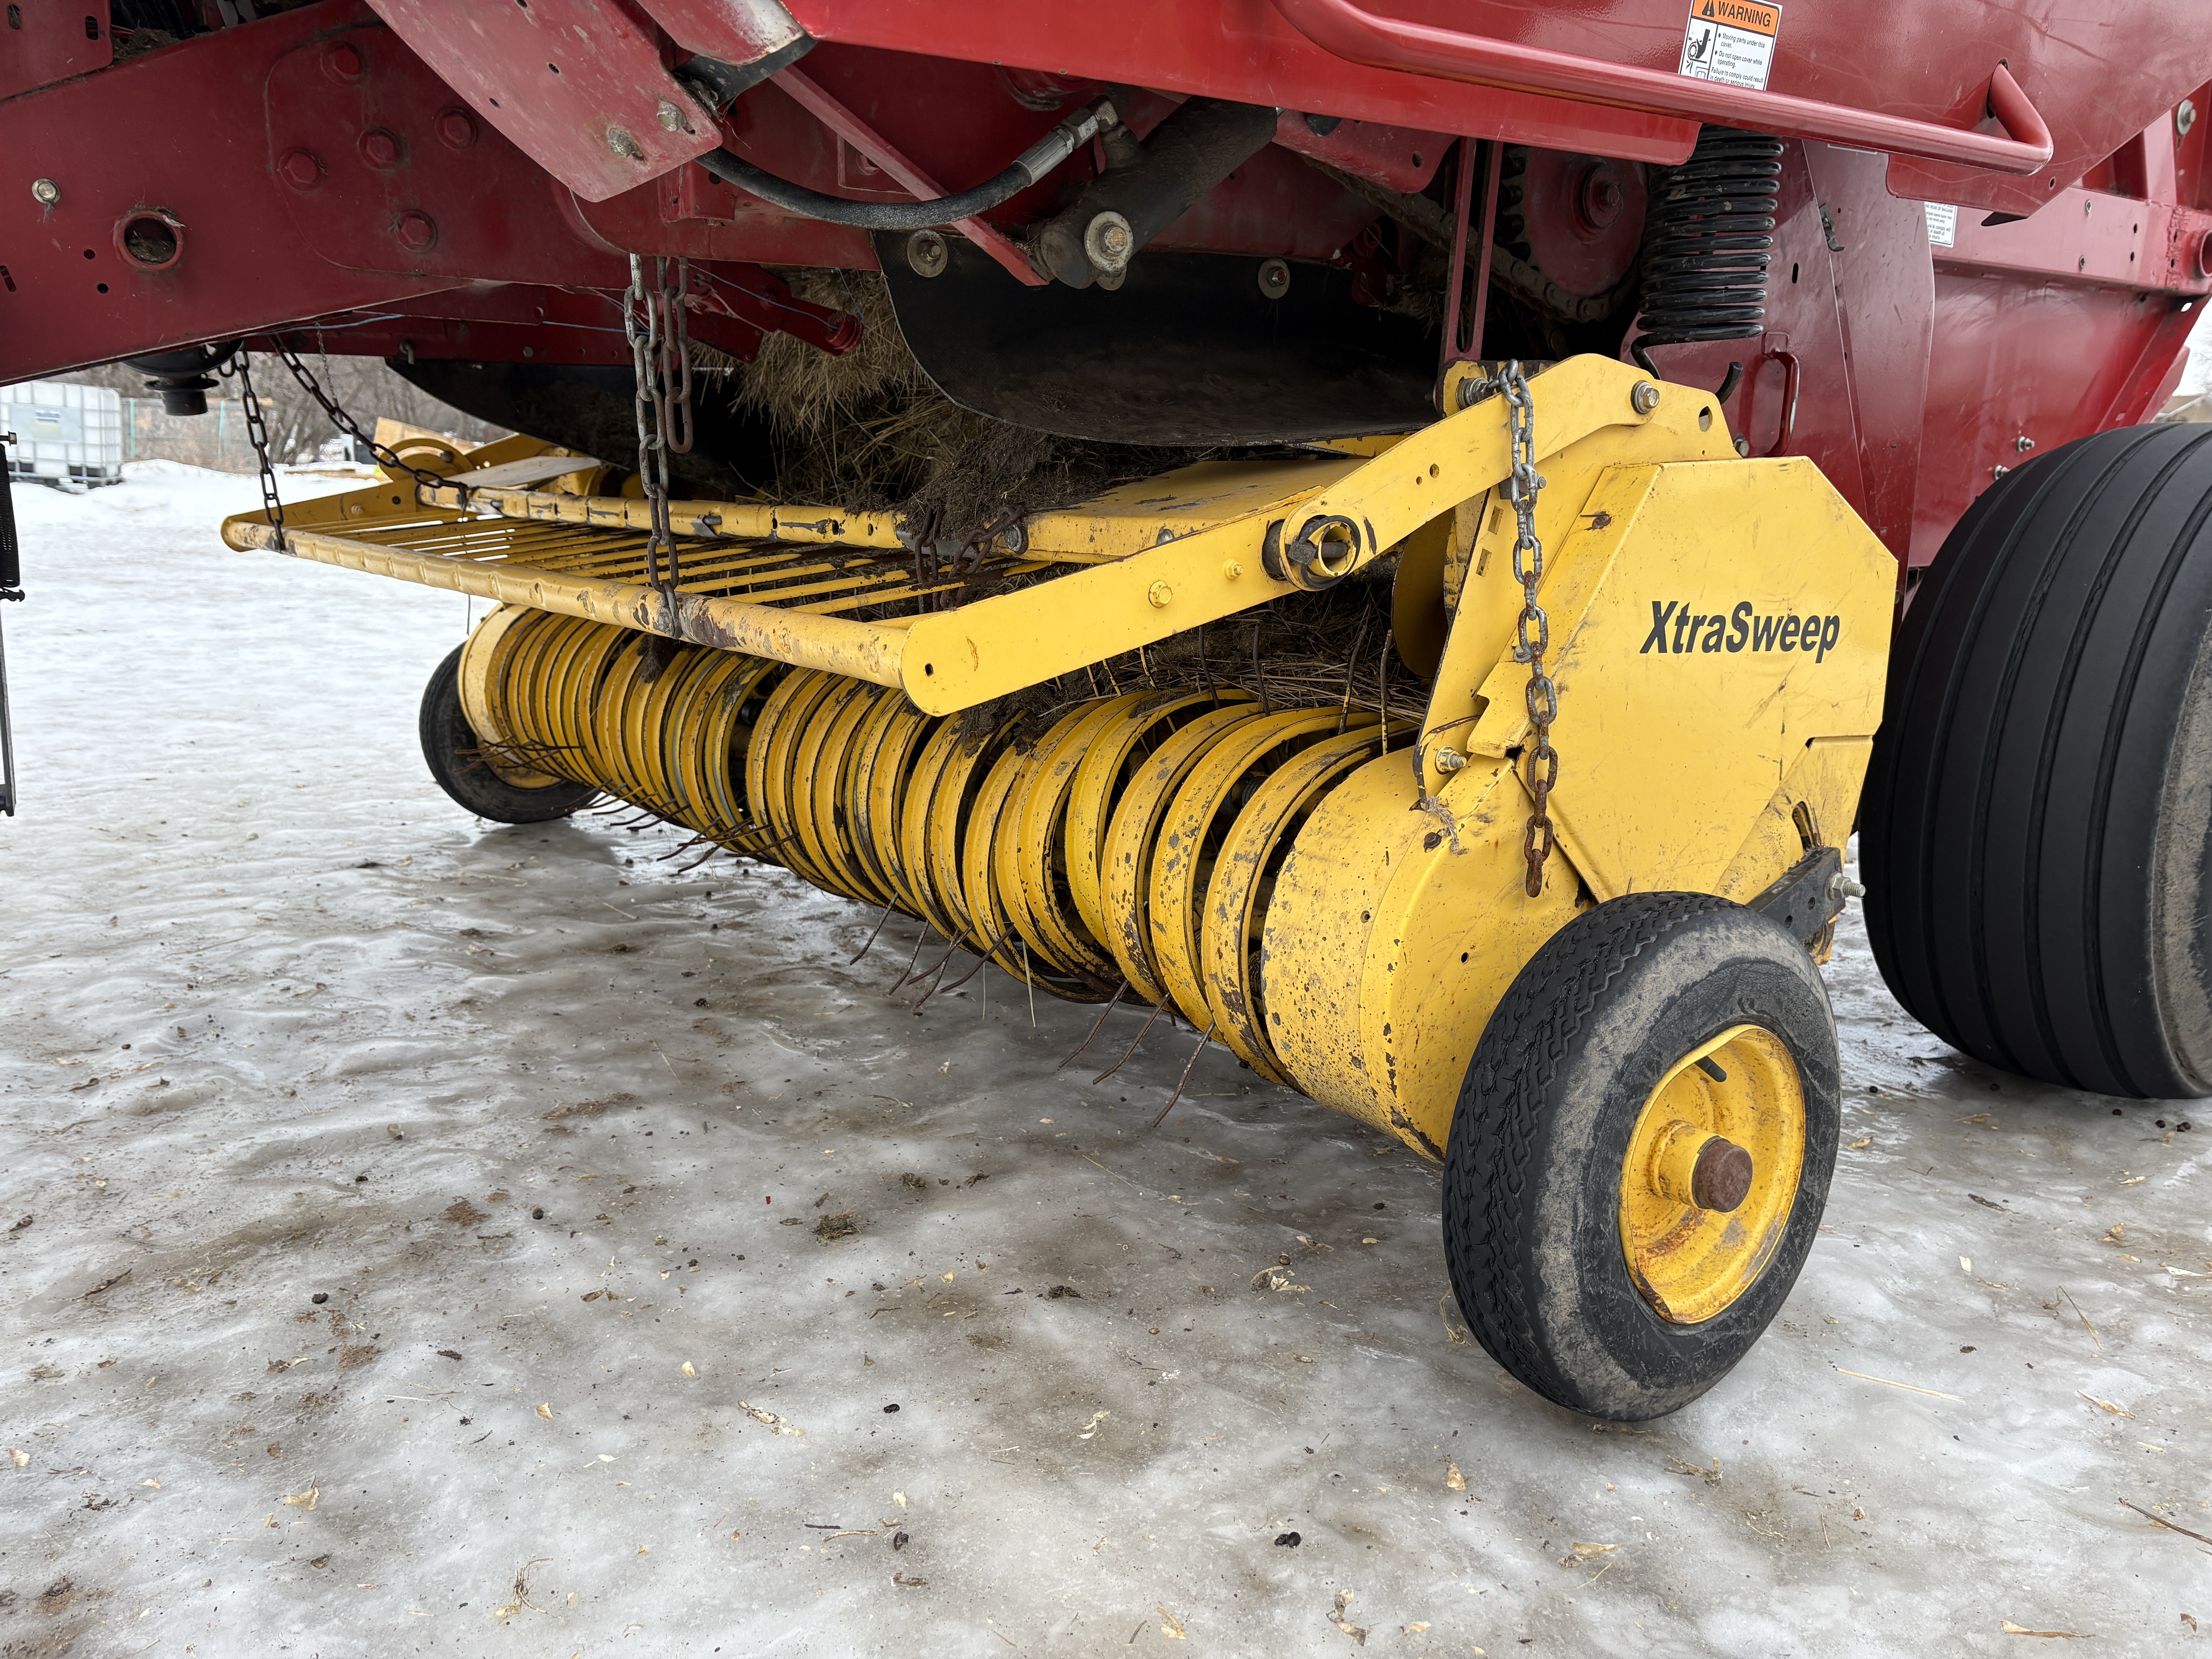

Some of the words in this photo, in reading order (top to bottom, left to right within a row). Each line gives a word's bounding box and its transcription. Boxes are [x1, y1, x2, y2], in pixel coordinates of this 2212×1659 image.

[1718, 1, 1771, 27] WARNING
[1729, 72, 1742, 80] comply
[1639, 601, 1840, 664] XtraSweep
